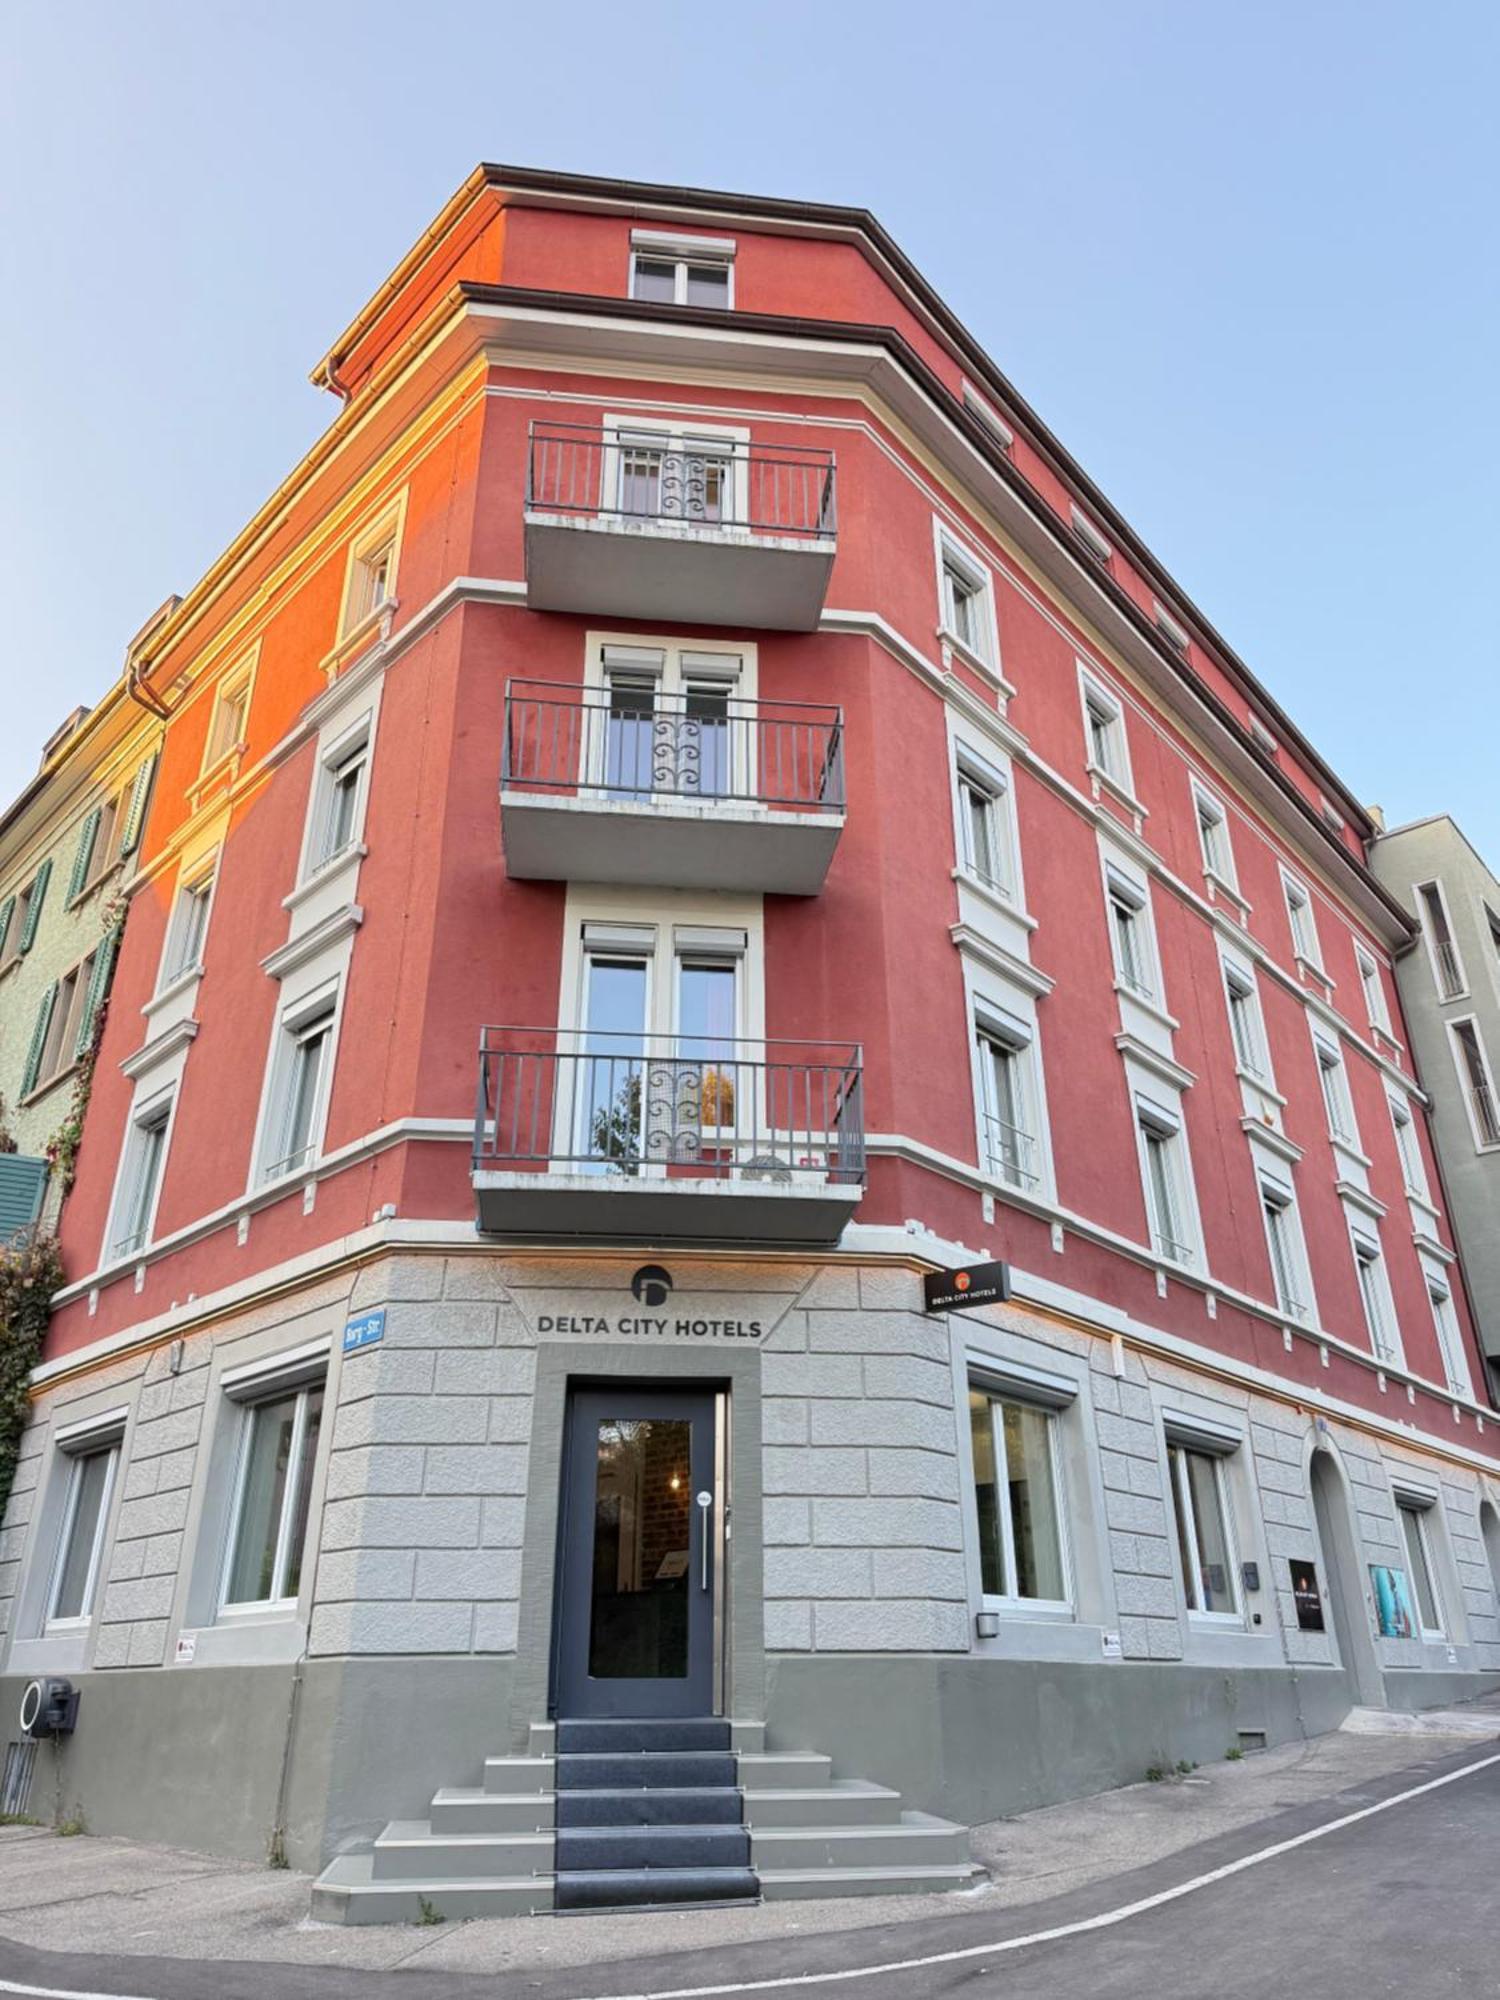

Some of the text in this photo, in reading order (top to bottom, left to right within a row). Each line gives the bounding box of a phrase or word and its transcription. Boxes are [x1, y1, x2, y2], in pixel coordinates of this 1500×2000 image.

[932, 1288, 996, 1305] DELTA CITY HOTELS
[538, 1316, 762, 1338] DELTA CITY HOTELS
